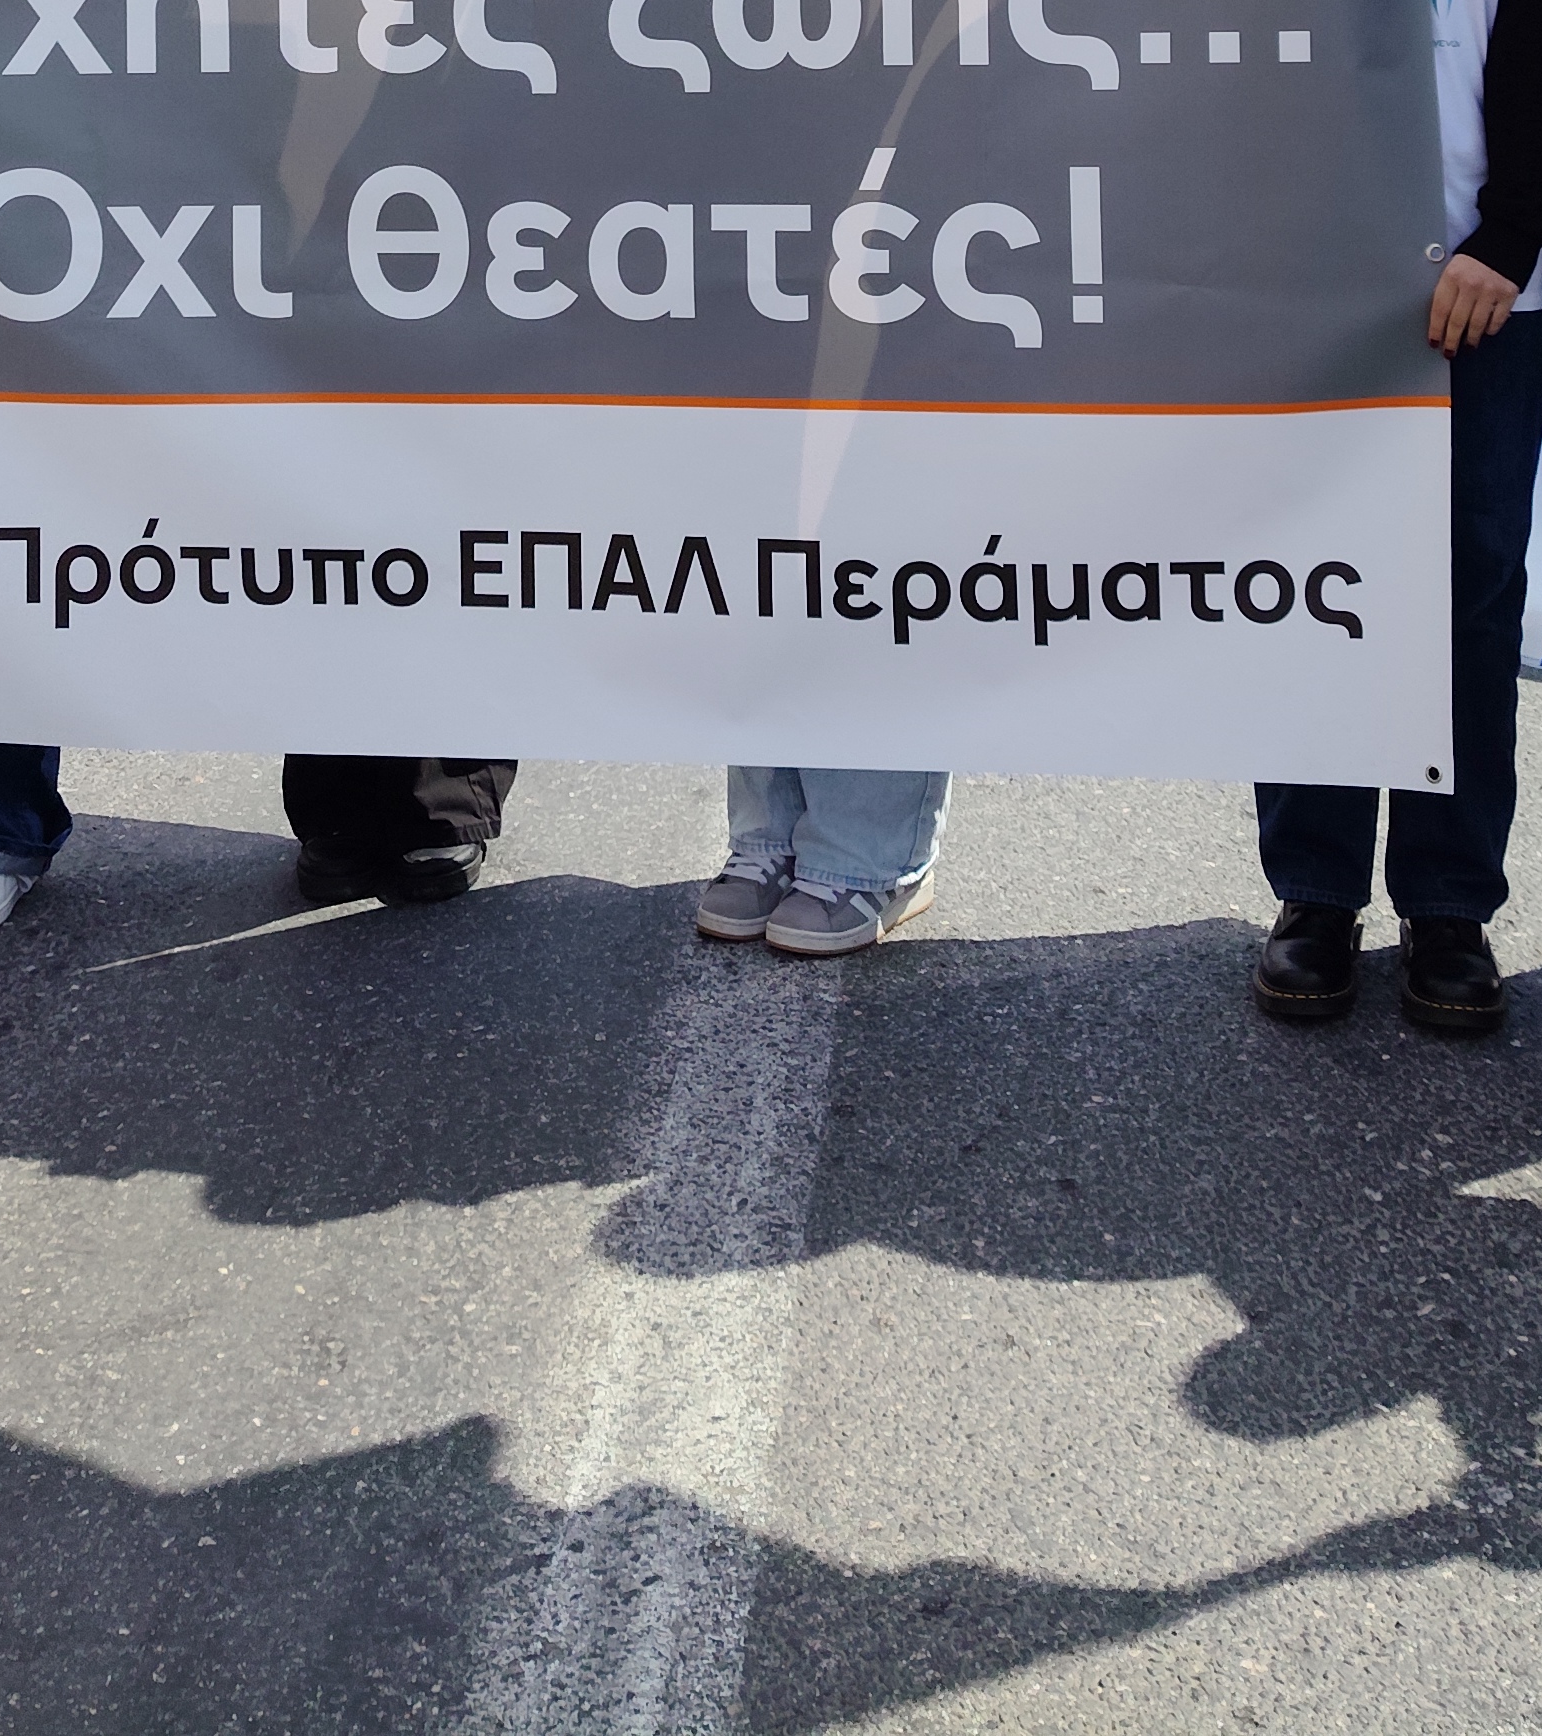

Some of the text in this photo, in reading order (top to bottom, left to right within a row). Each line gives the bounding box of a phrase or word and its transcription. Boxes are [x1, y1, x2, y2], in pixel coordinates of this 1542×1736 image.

[347, 147, 1104, 349] θεατές!
[459, 530, 730, 616] ΕΠΑΛ
[757, 534, 1365, 647] Περάματος
